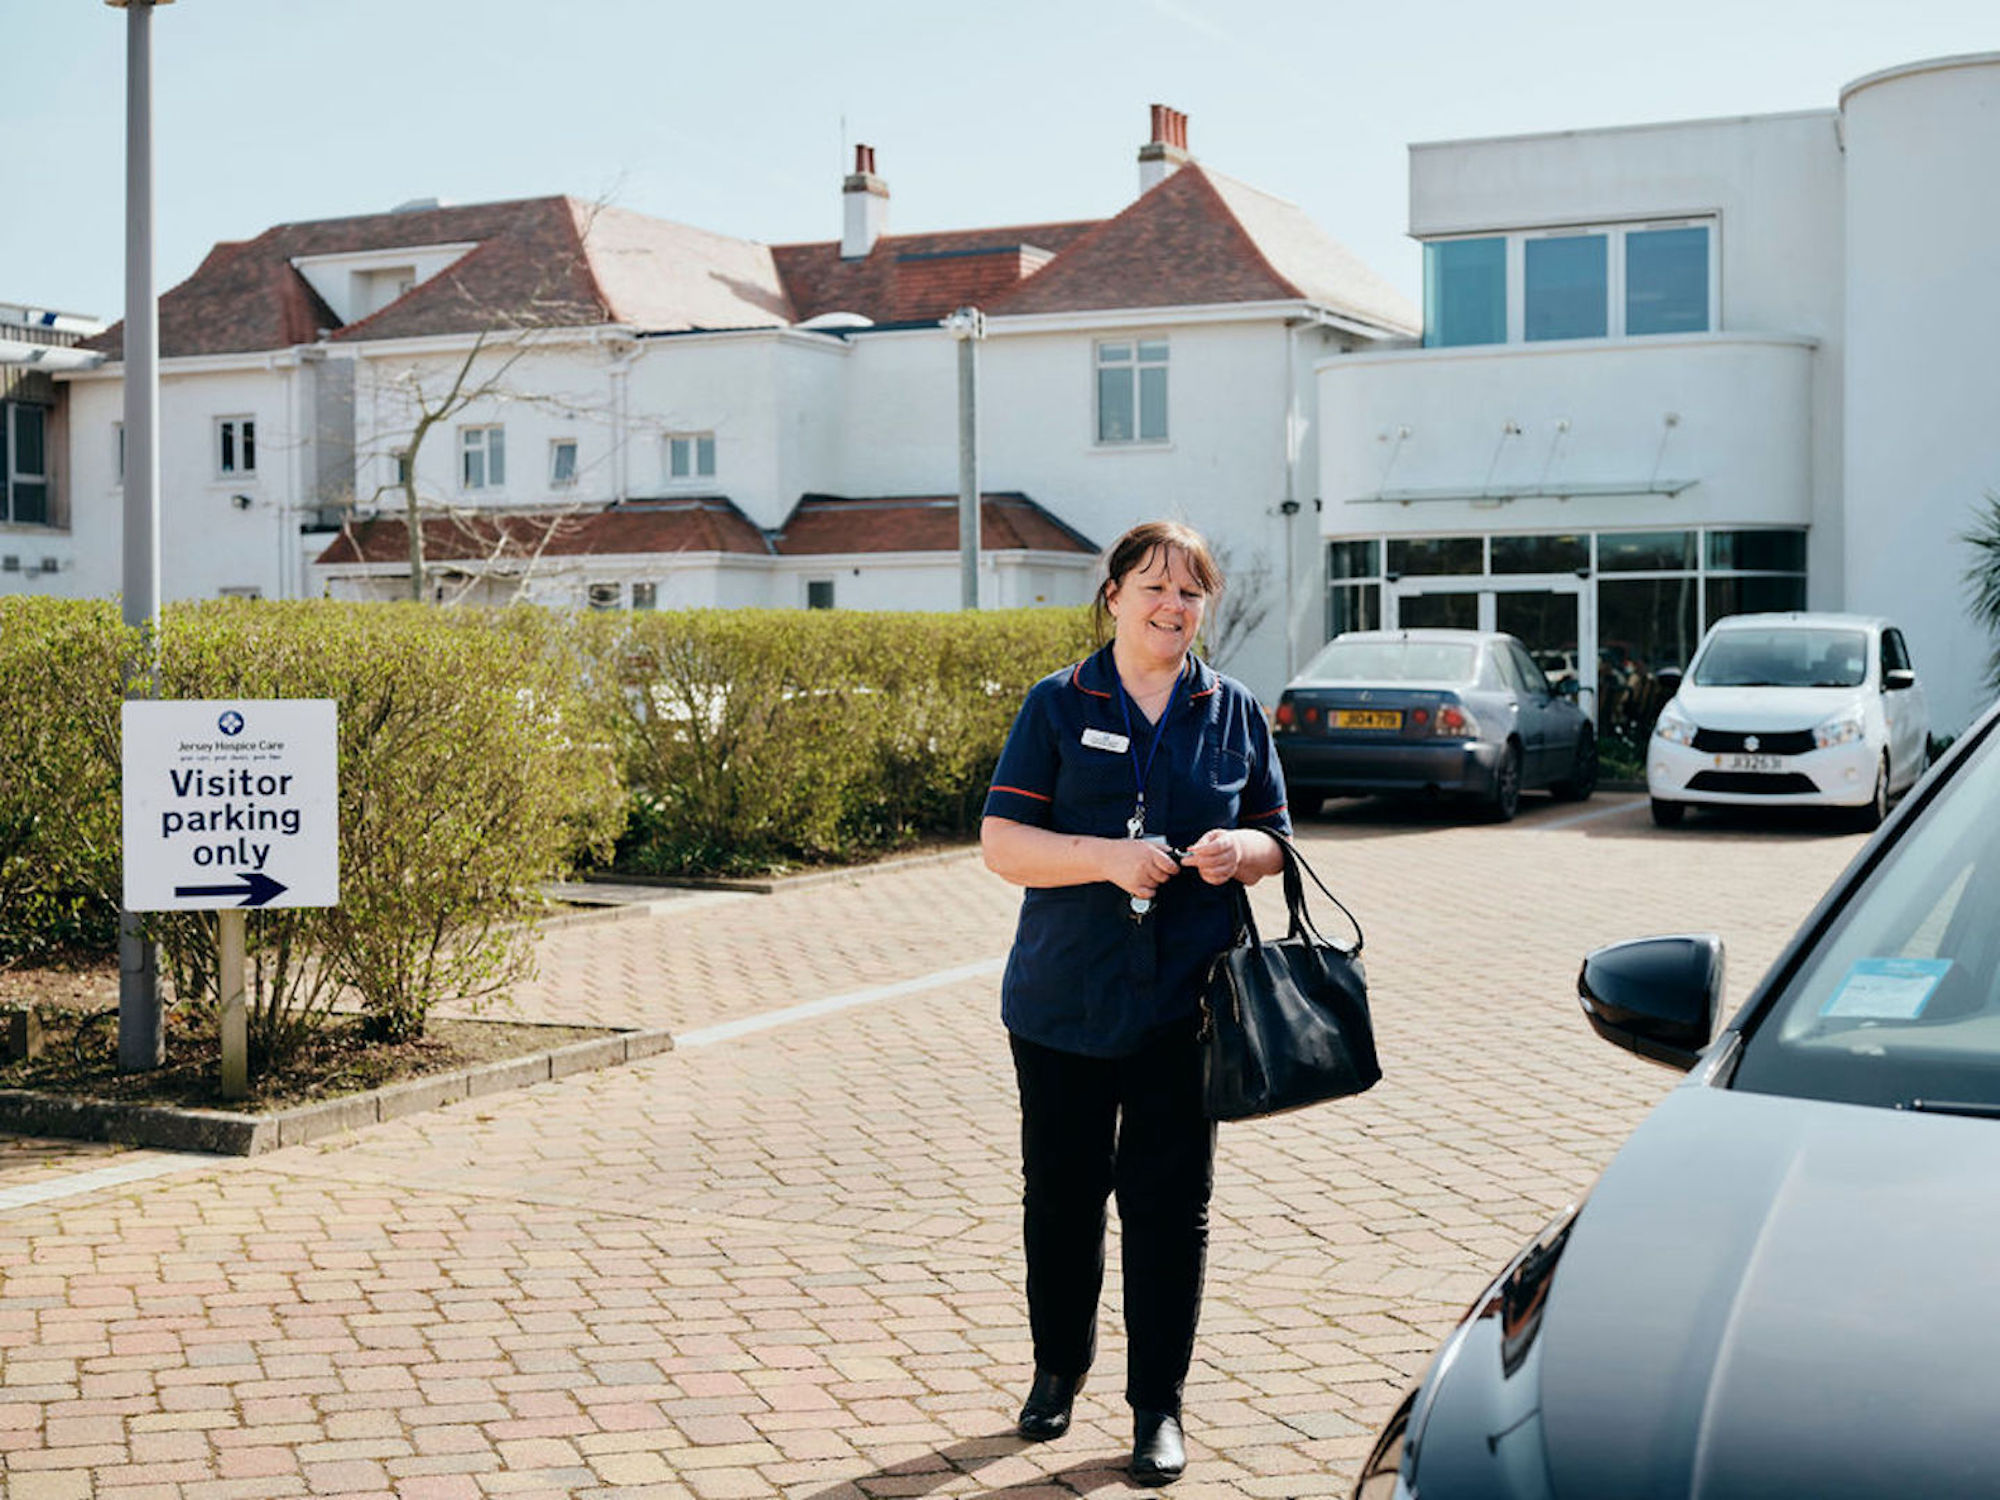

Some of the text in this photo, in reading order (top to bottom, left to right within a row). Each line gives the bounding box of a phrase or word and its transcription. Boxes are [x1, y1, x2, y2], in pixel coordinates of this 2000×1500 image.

[178, 740, 285, 753] Jersey Hospice Care
[170, 768, 293, 798] Visitor
[162, 803, 300, 838] parking
[193, 837, 271, 870] only
